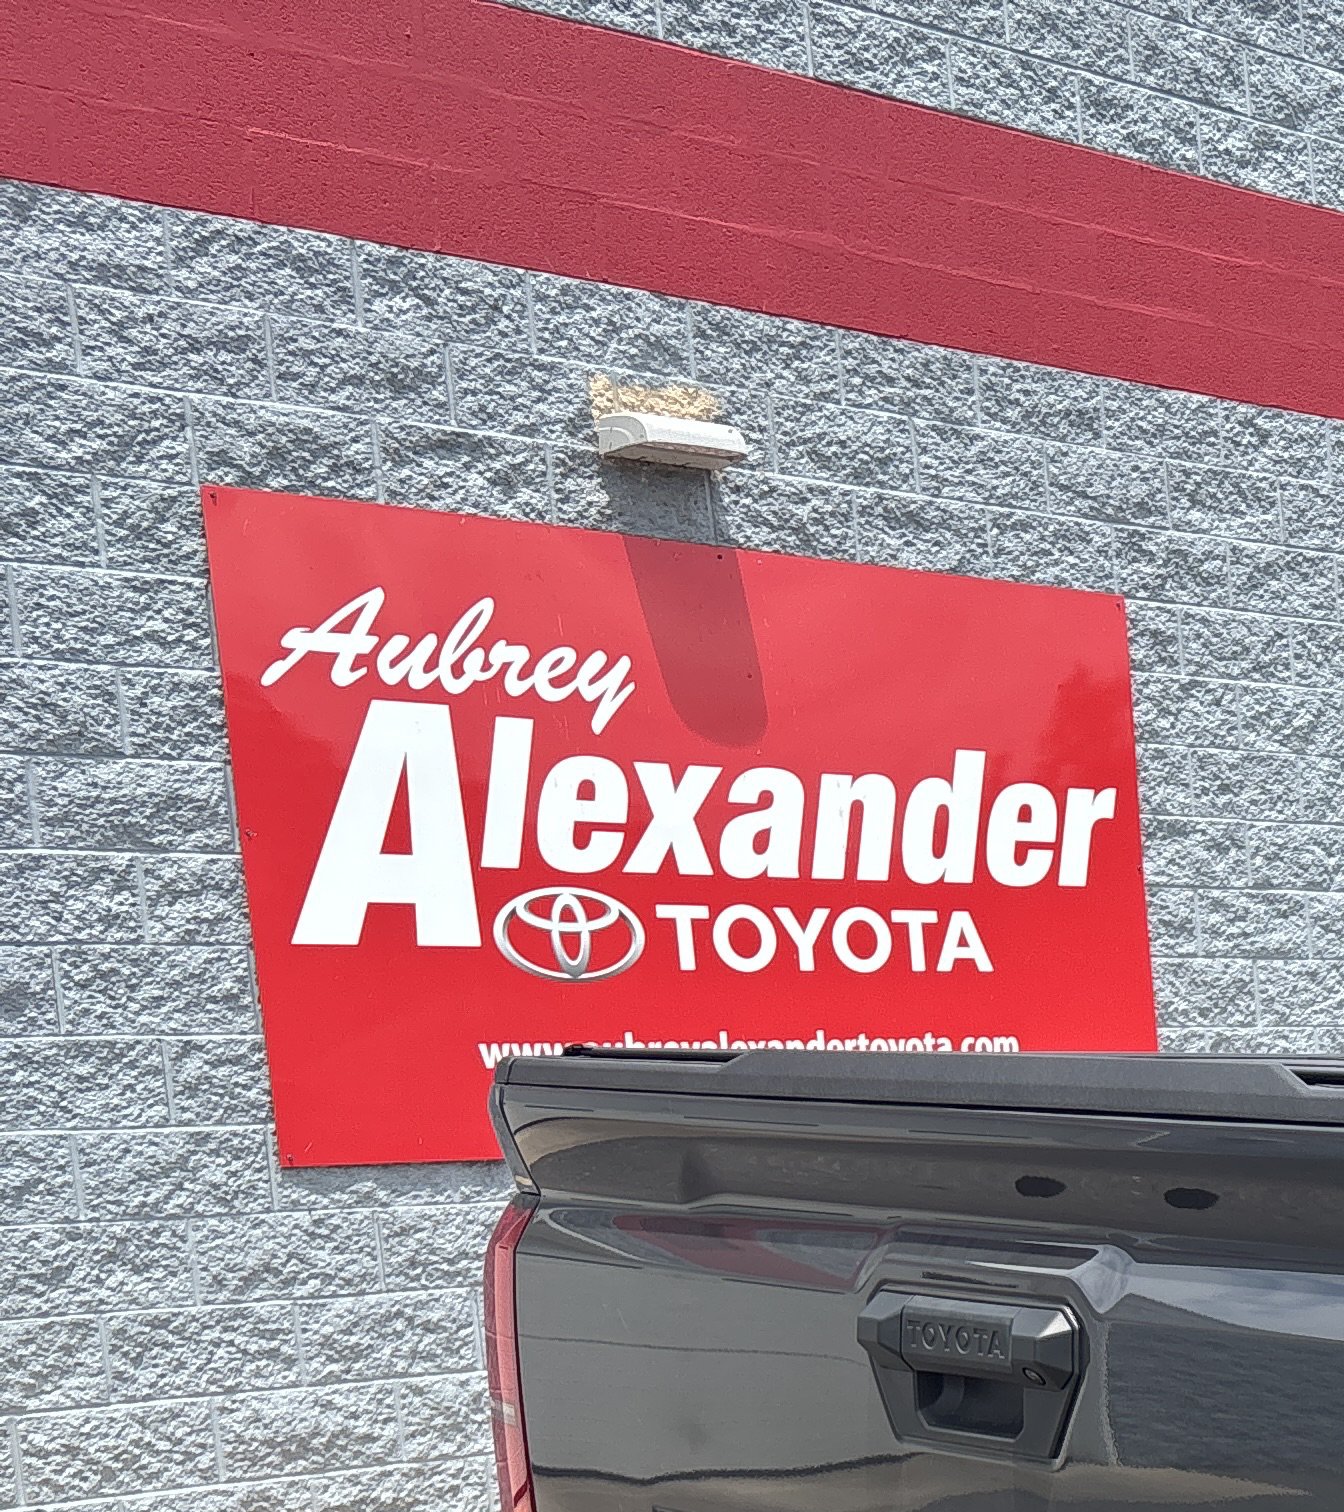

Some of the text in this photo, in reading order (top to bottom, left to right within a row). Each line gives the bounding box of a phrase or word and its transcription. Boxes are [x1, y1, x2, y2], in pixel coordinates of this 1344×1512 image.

[260, 587, 636, 735] Aubrey
[290, 699, 1117, 948] Alexander
[655, 903, 994, 974] TOYOTA
[906, 1319, 1006, 1360] TOYOTA
